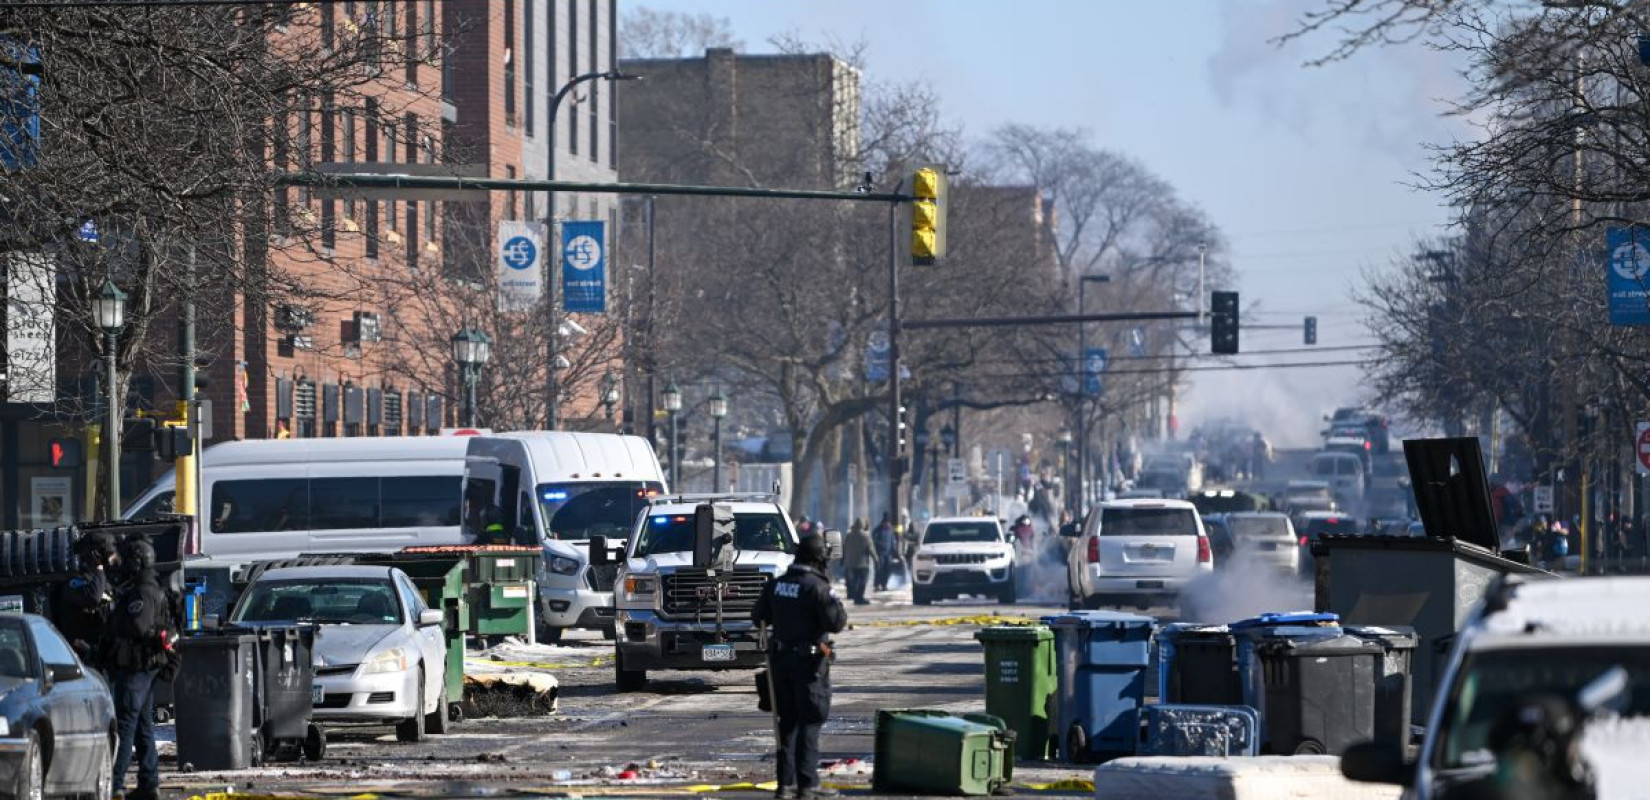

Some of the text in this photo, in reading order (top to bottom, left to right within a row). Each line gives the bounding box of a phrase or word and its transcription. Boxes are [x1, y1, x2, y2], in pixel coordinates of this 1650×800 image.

[1628, 290, 1650, 298] stre
[14, 351, 49, 361] PIZZA
[773, 581, 800, 598] POLICE
